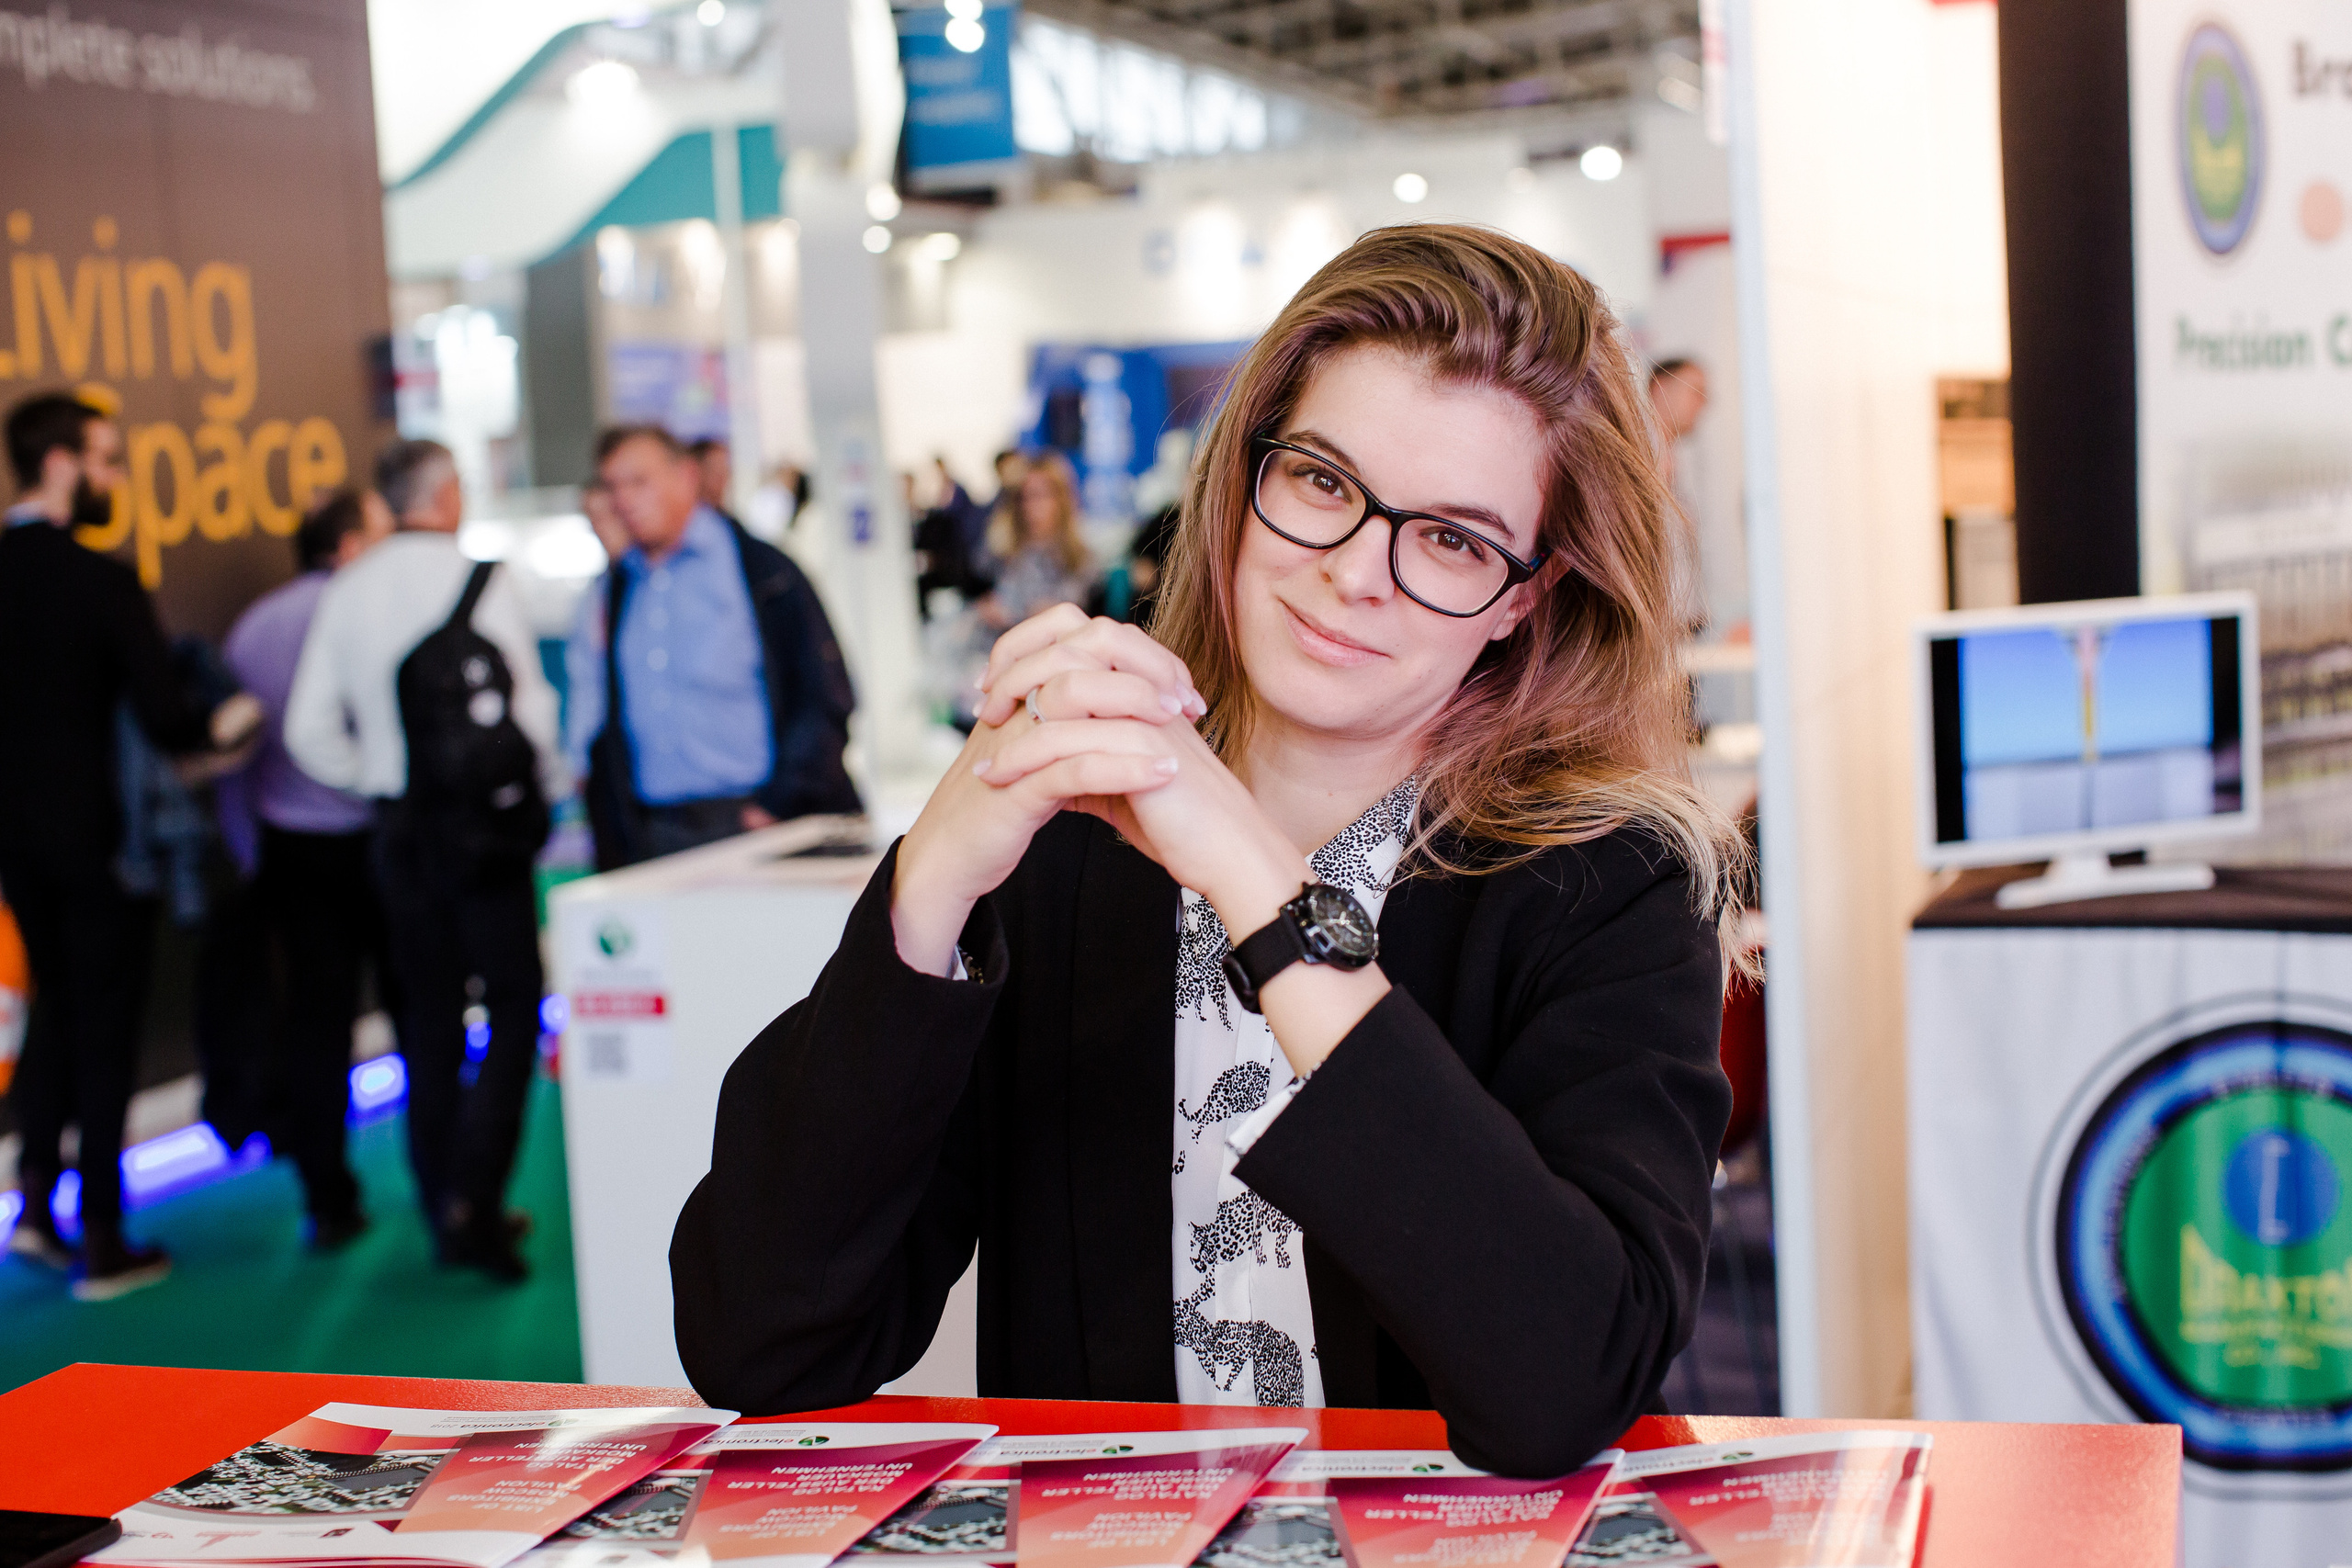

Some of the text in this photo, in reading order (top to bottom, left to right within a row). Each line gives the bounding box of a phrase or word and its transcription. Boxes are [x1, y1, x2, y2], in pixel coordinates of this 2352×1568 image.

[514, 1441, 647, 1451] UNTERNEN
[771, 1462, 913, 1474] UNTERNEHMEN
[796, 1470, 905, 1481] MOSKAUER
[494, 1480, 582, 1491] PAVILION
[727, 1479, 850, 1489] AUSSTELLER
[481, 1487, 570, 1498] MOSCOW
